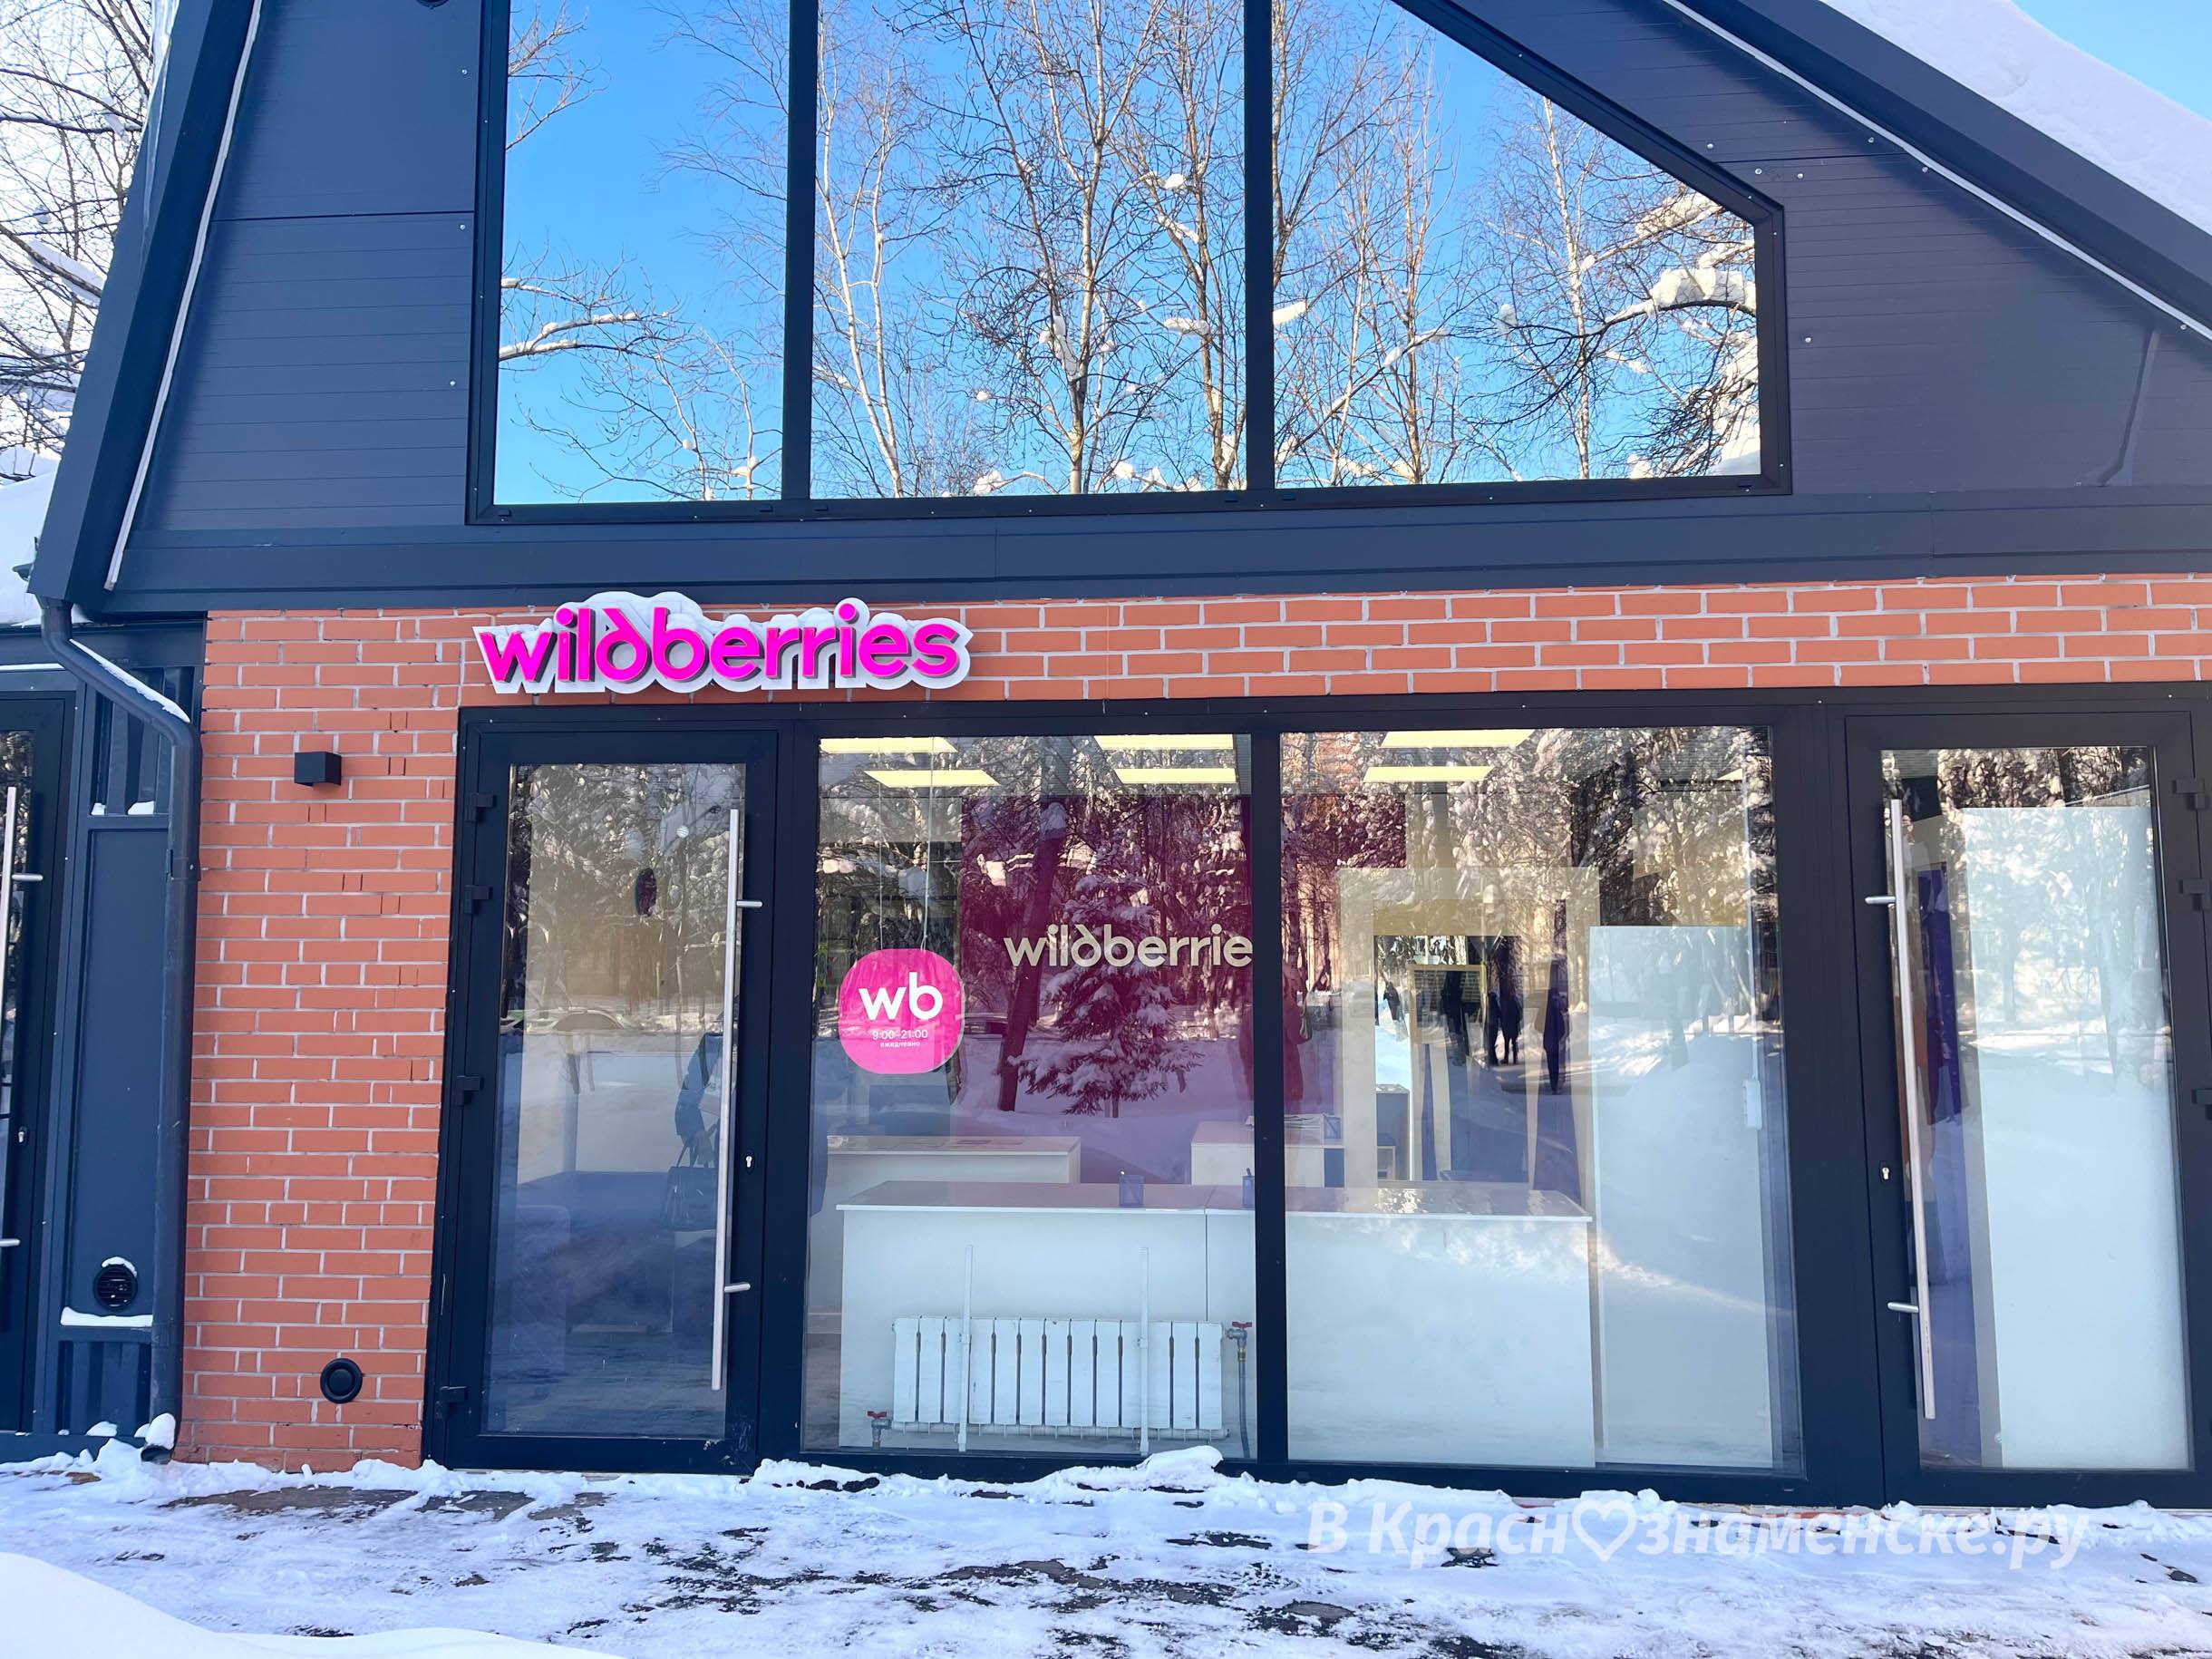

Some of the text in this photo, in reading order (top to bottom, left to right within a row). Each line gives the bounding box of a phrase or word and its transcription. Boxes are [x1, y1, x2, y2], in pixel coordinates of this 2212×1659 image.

[479, 603, 960, 683] wildberries
[1004, 923, 1254, 967] wildberrie
[859, 972, 944, 1021] wb
